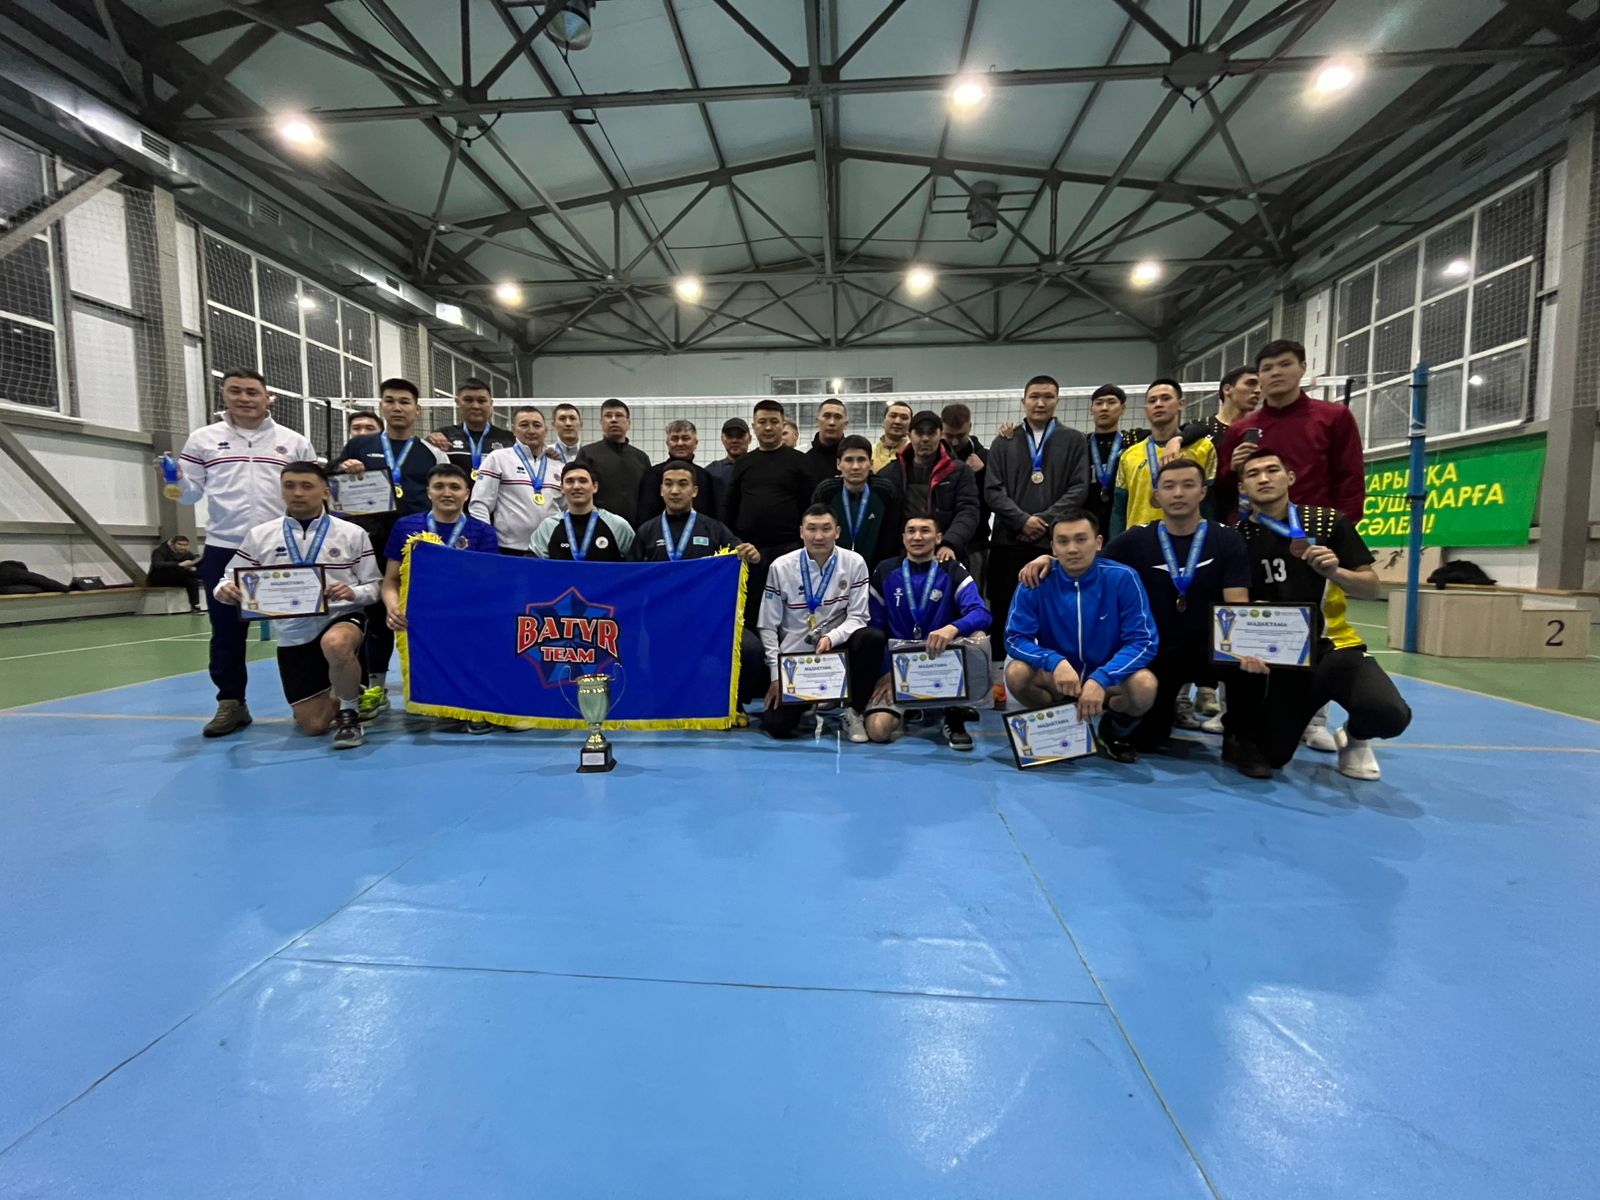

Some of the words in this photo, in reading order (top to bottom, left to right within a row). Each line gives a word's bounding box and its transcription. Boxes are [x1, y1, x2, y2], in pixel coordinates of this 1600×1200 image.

[1365, 462, 1457, 492] АРЫҚА
[1363, 482, 1504, 514] СУШЛАРҒА
[1261, 558, 1287, 583] 13
[517, 616, 619, 658] BATYR
[1545, 620, 1565, 646] 2
[540, 646, 595, 663] TEAM
